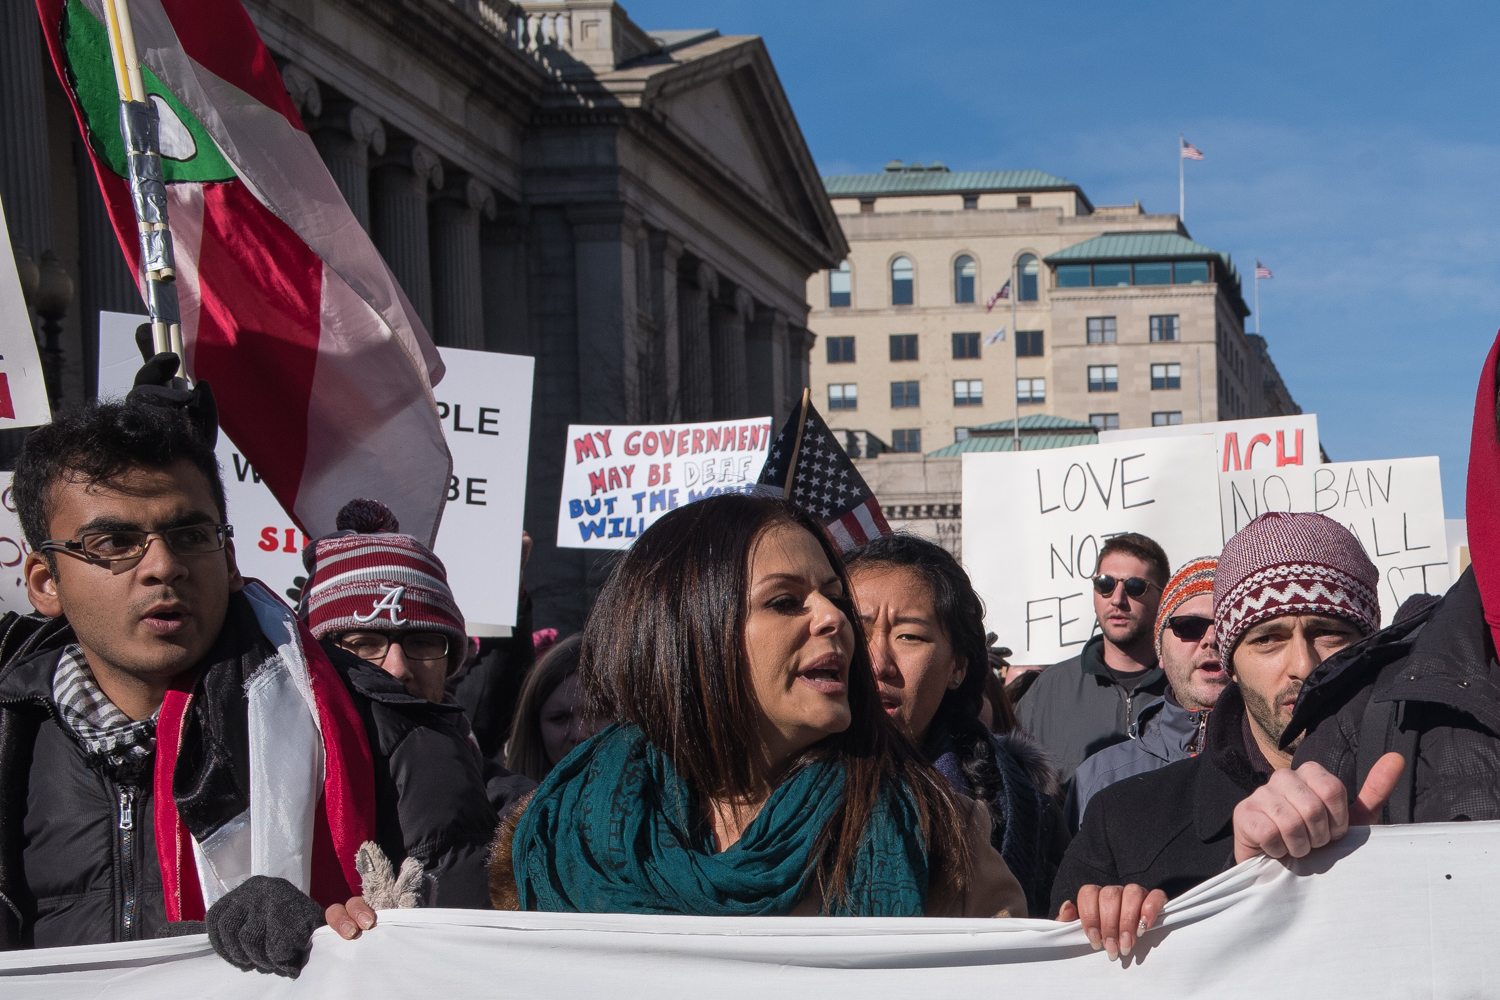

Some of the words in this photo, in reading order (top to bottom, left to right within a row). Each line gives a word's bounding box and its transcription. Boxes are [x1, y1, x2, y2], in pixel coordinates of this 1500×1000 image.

[573, 429, 613, 466] MY
[624, 424, 772, 458] GOVERNMENT
[588, 464, 636, 497] MAY
[647, 463, 673, 488] BE
[683, 455, 753, 489] DEAF
[1036, 453, 1156, 515] LOVE
[569, 496, 618, 519] BUT
[632, 488, 680, 514] THE
[1231, 474, 1292, 534] NO
[1314, 465, 1393, 513] BAN
[354, 583, 408, 627] A
